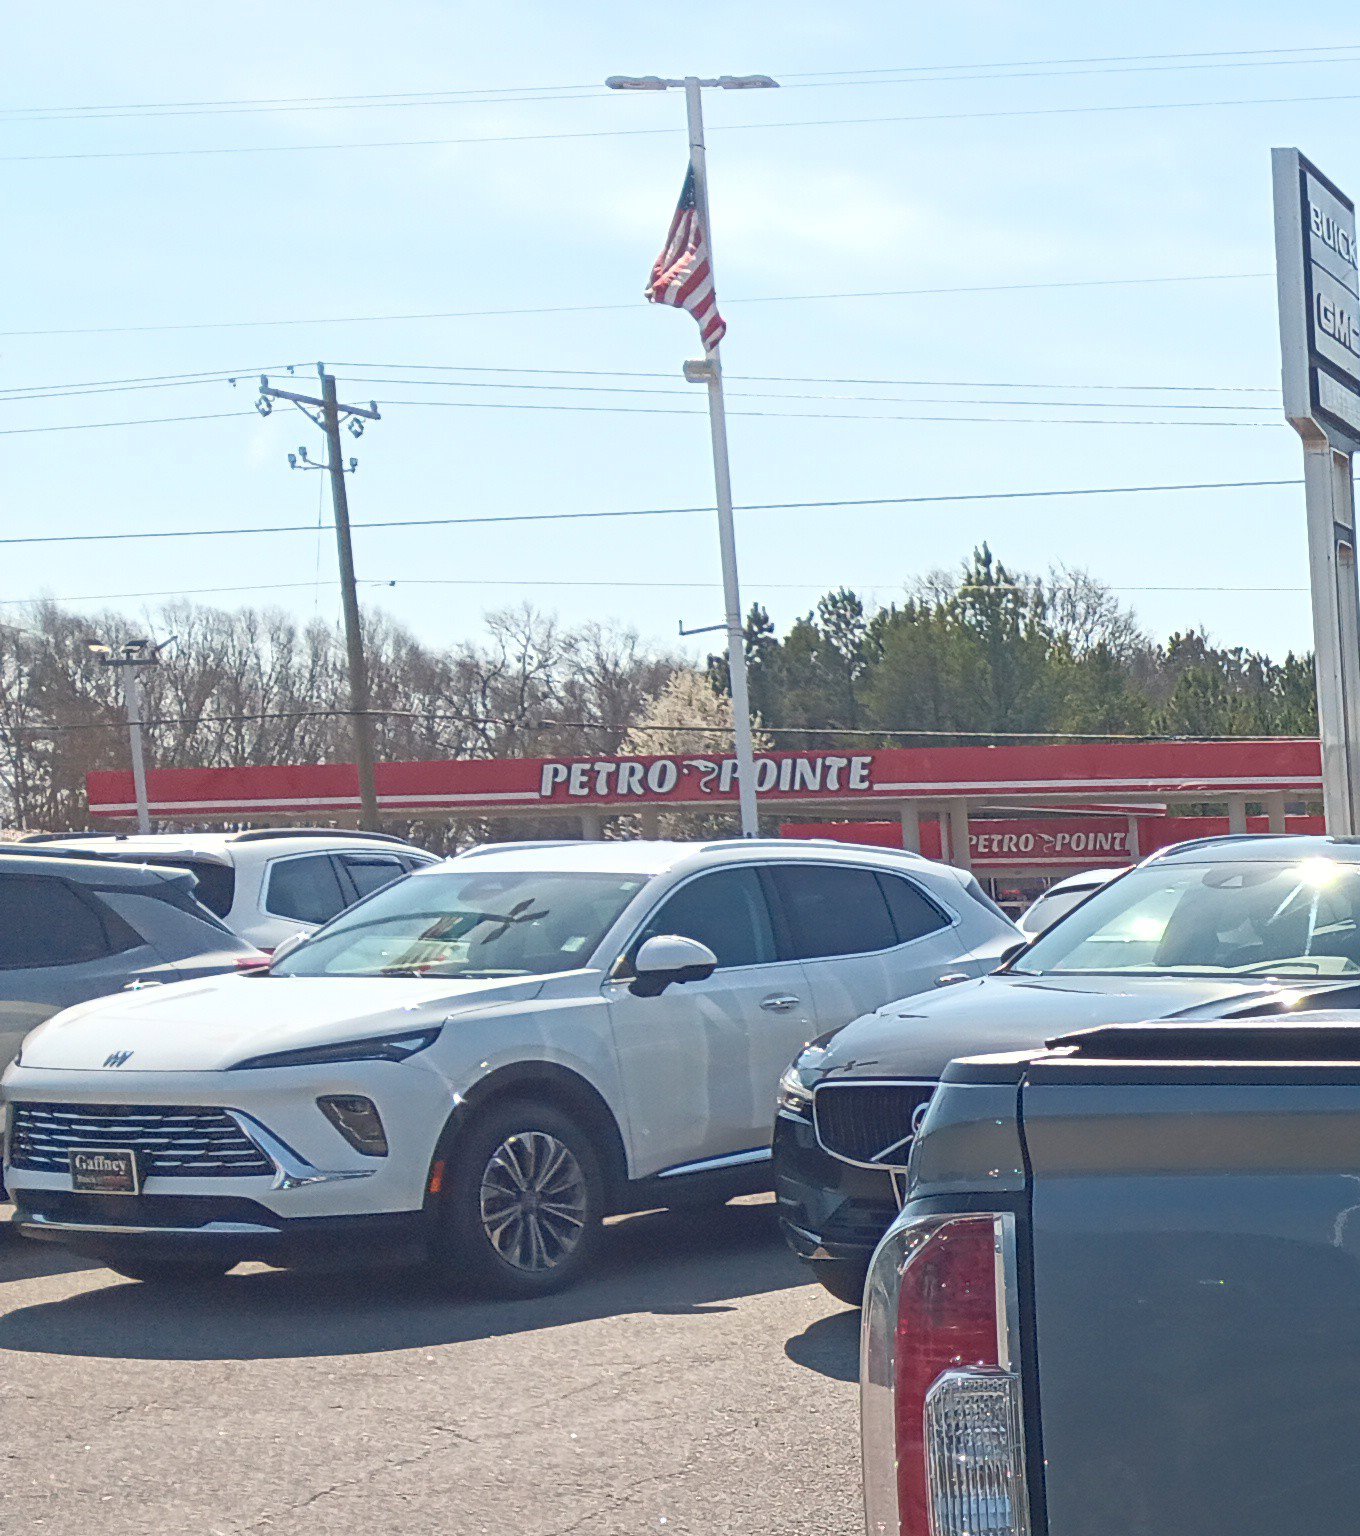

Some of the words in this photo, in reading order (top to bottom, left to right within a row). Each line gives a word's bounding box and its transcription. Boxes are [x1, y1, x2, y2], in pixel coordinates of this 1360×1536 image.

[1309, 202, 1358, 271] BUICK
[1316, 291, 1360, 358] GMC
[541, 759, 678, 796] PETRO
[719, 755, 873, 791] POINTE
[1055, 832, 1129, 852] POINT
[75, 1154, 127, 1175] Gaffney
